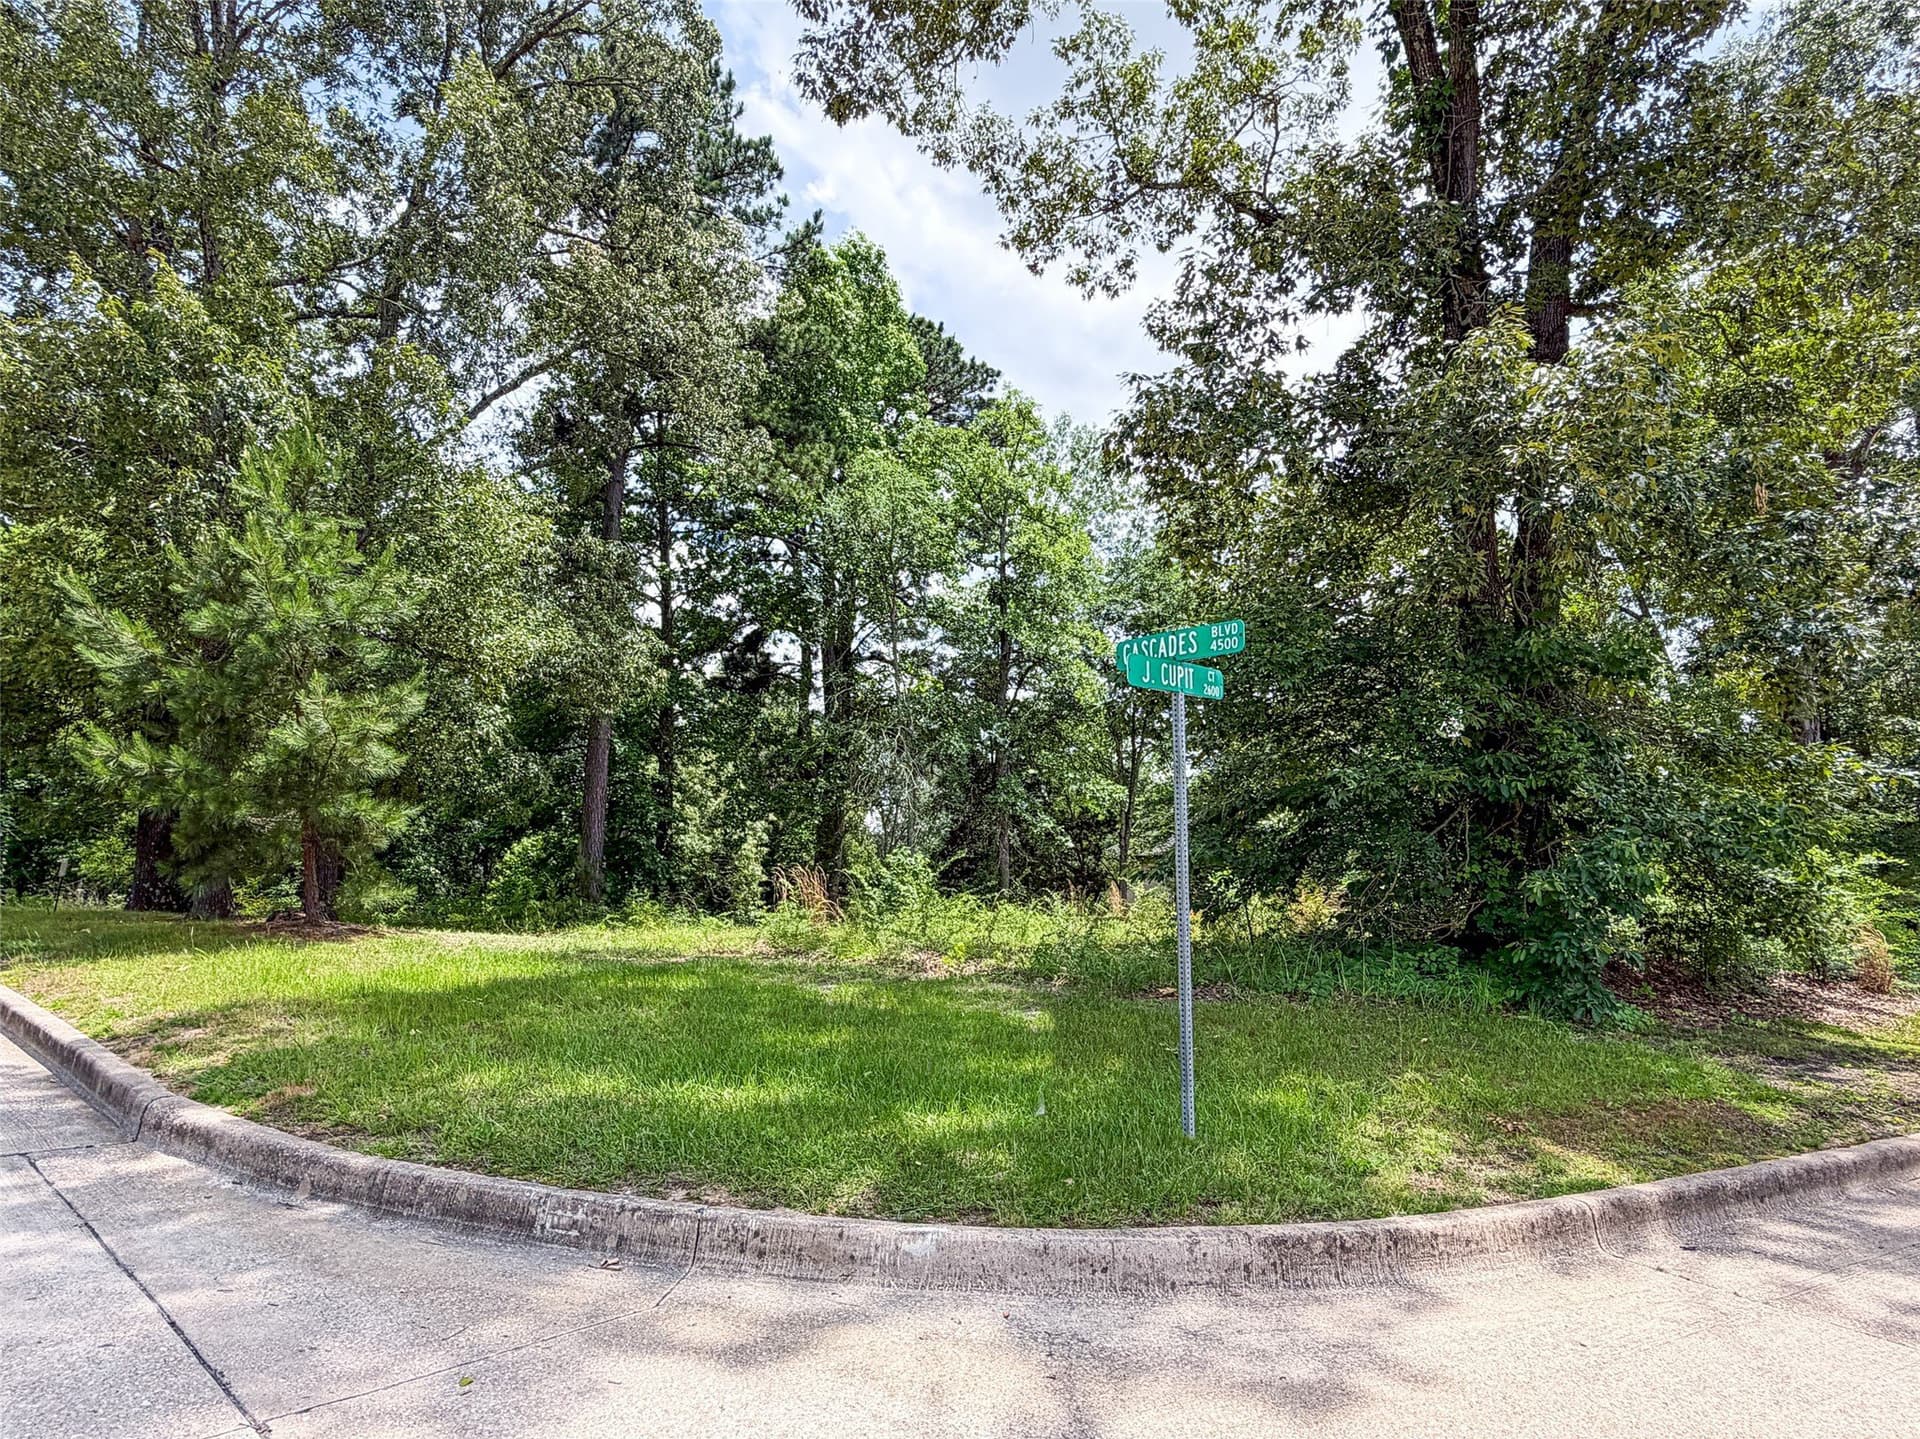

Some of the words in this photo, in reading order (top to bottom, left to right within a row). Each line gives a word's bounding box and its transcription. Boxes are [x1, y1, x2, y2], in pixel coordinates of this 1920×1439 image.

[1123, 631, 1197, 665] CASCADES
[1211, 623, 1238, 637] BLVD
[1210, 637, 1238, 651] 4500
[1142, 660, 1155, 684] J.
[1161, 663, 1194, 690] CUPIT
